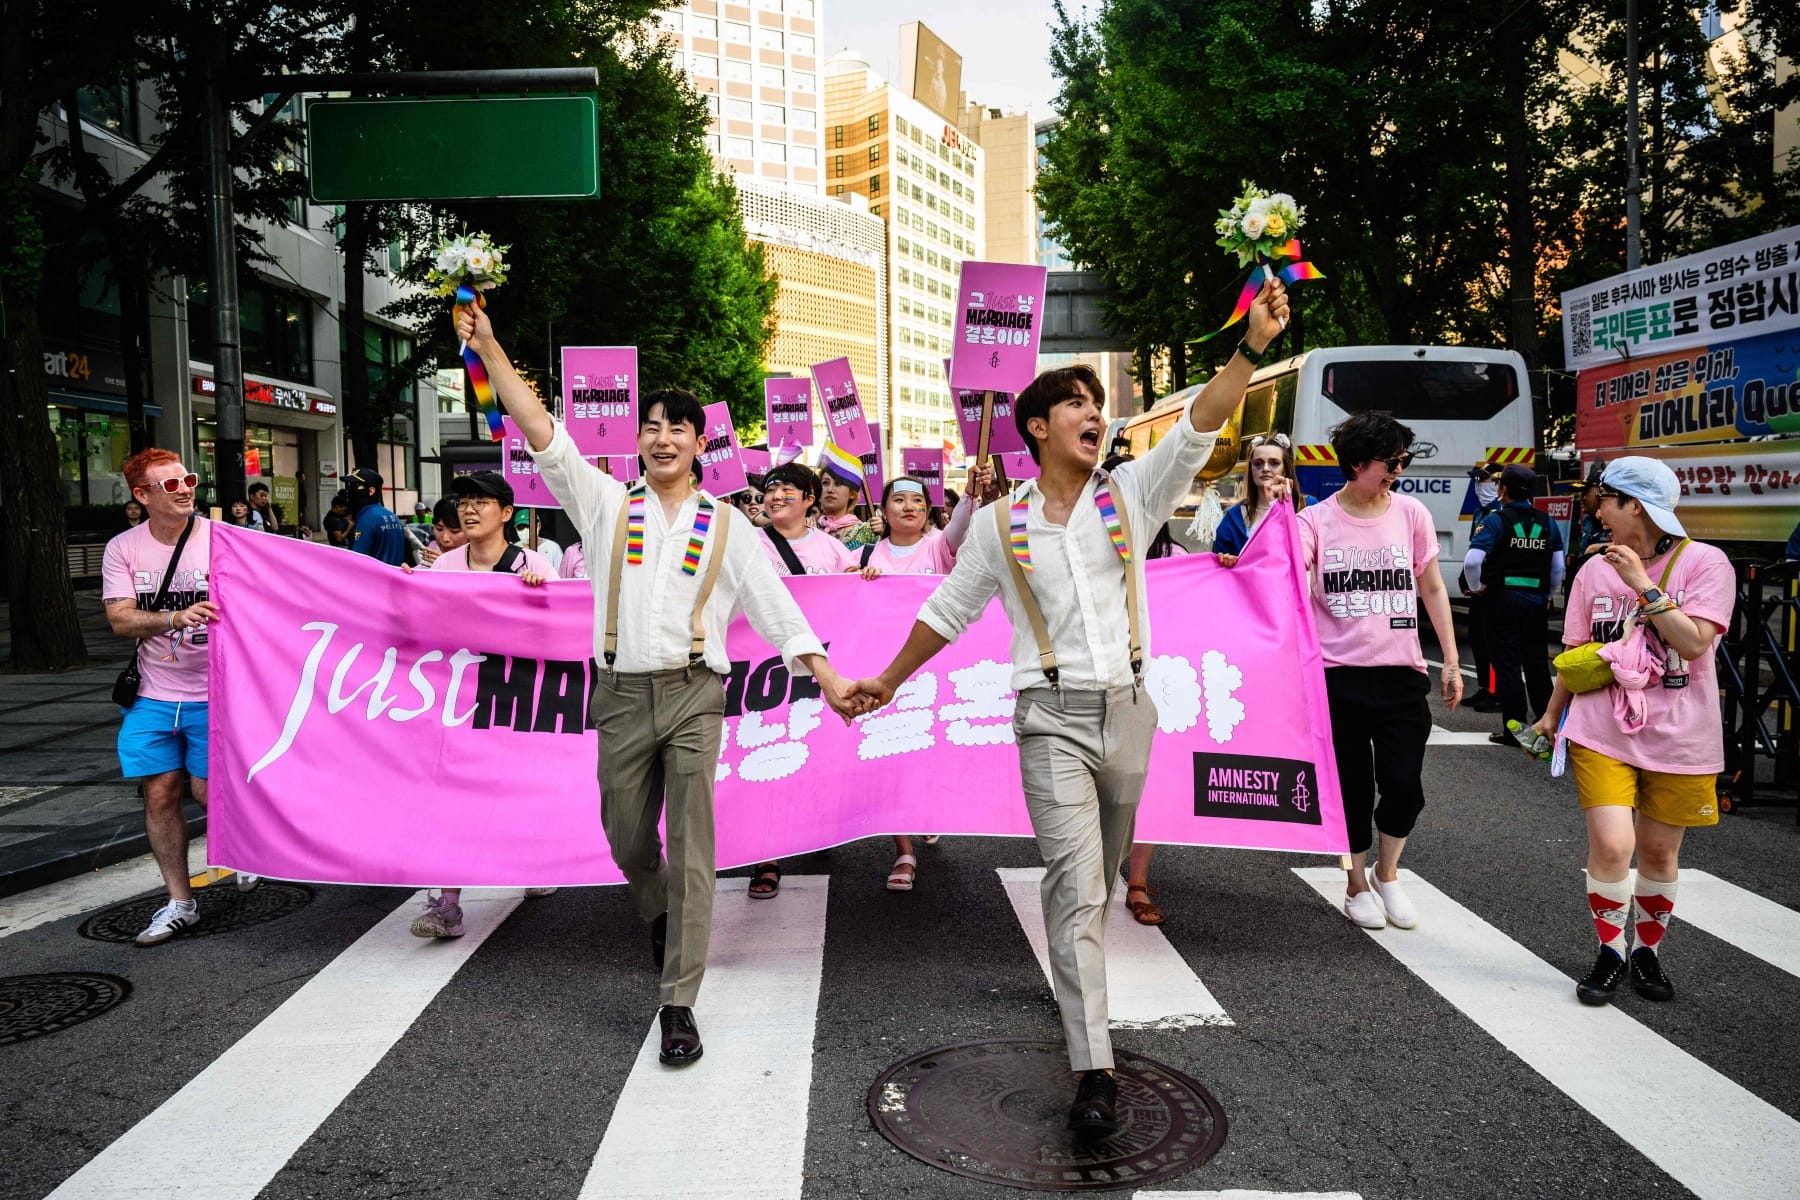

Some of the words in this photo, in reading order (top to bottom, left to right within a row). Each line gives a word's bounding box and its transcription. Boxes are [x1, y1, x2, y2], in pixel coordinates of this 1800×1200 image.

[1591, 289, 1609, 312] 일본
[1611, 277, 1656, 306] 후쿠시마
[1659, 268, 1700, 295] 방사능
[1704, 254, 1751, 284] 오염수
[1755, 243, 1789, 272] 방출
[966, 308, 1033, 330] MARRIAGE
[1592, 295, 1700, 351] 국민투표로
[966, 325, 1031, 348] 결혼이야
[1595, 381, 1607, 408] 더
[1609, 369, 1650, 404] 퀴어한
[1654, 359, 1690, 395] 삶을
[1694, 348, 1739, 384] 위해,
[572, 389, 630, 404] MARRIAGE
[772, 403, 808, 413] MARRIAGE
[828, 393, 858, 413] MARRIAGE
[573, 403, 630, 419] 결혼이야
[772, 412, 808, 423] 결혼이야
[1638, 384, 1736, 440] 피어나라
[1510, 537, 1546, 551] POLICE
[1323, 569, 1413, 594] MARRIAGE
[1326, 592, 1415, 618] 결혼이야
[246, 621, 487, 783] Just
[851, 648, 1246, 760] 결혼야
[1208, 768, 1280, 791] AMNESTY
[1208, 790, 1279, 807] INTERNATIONAL
